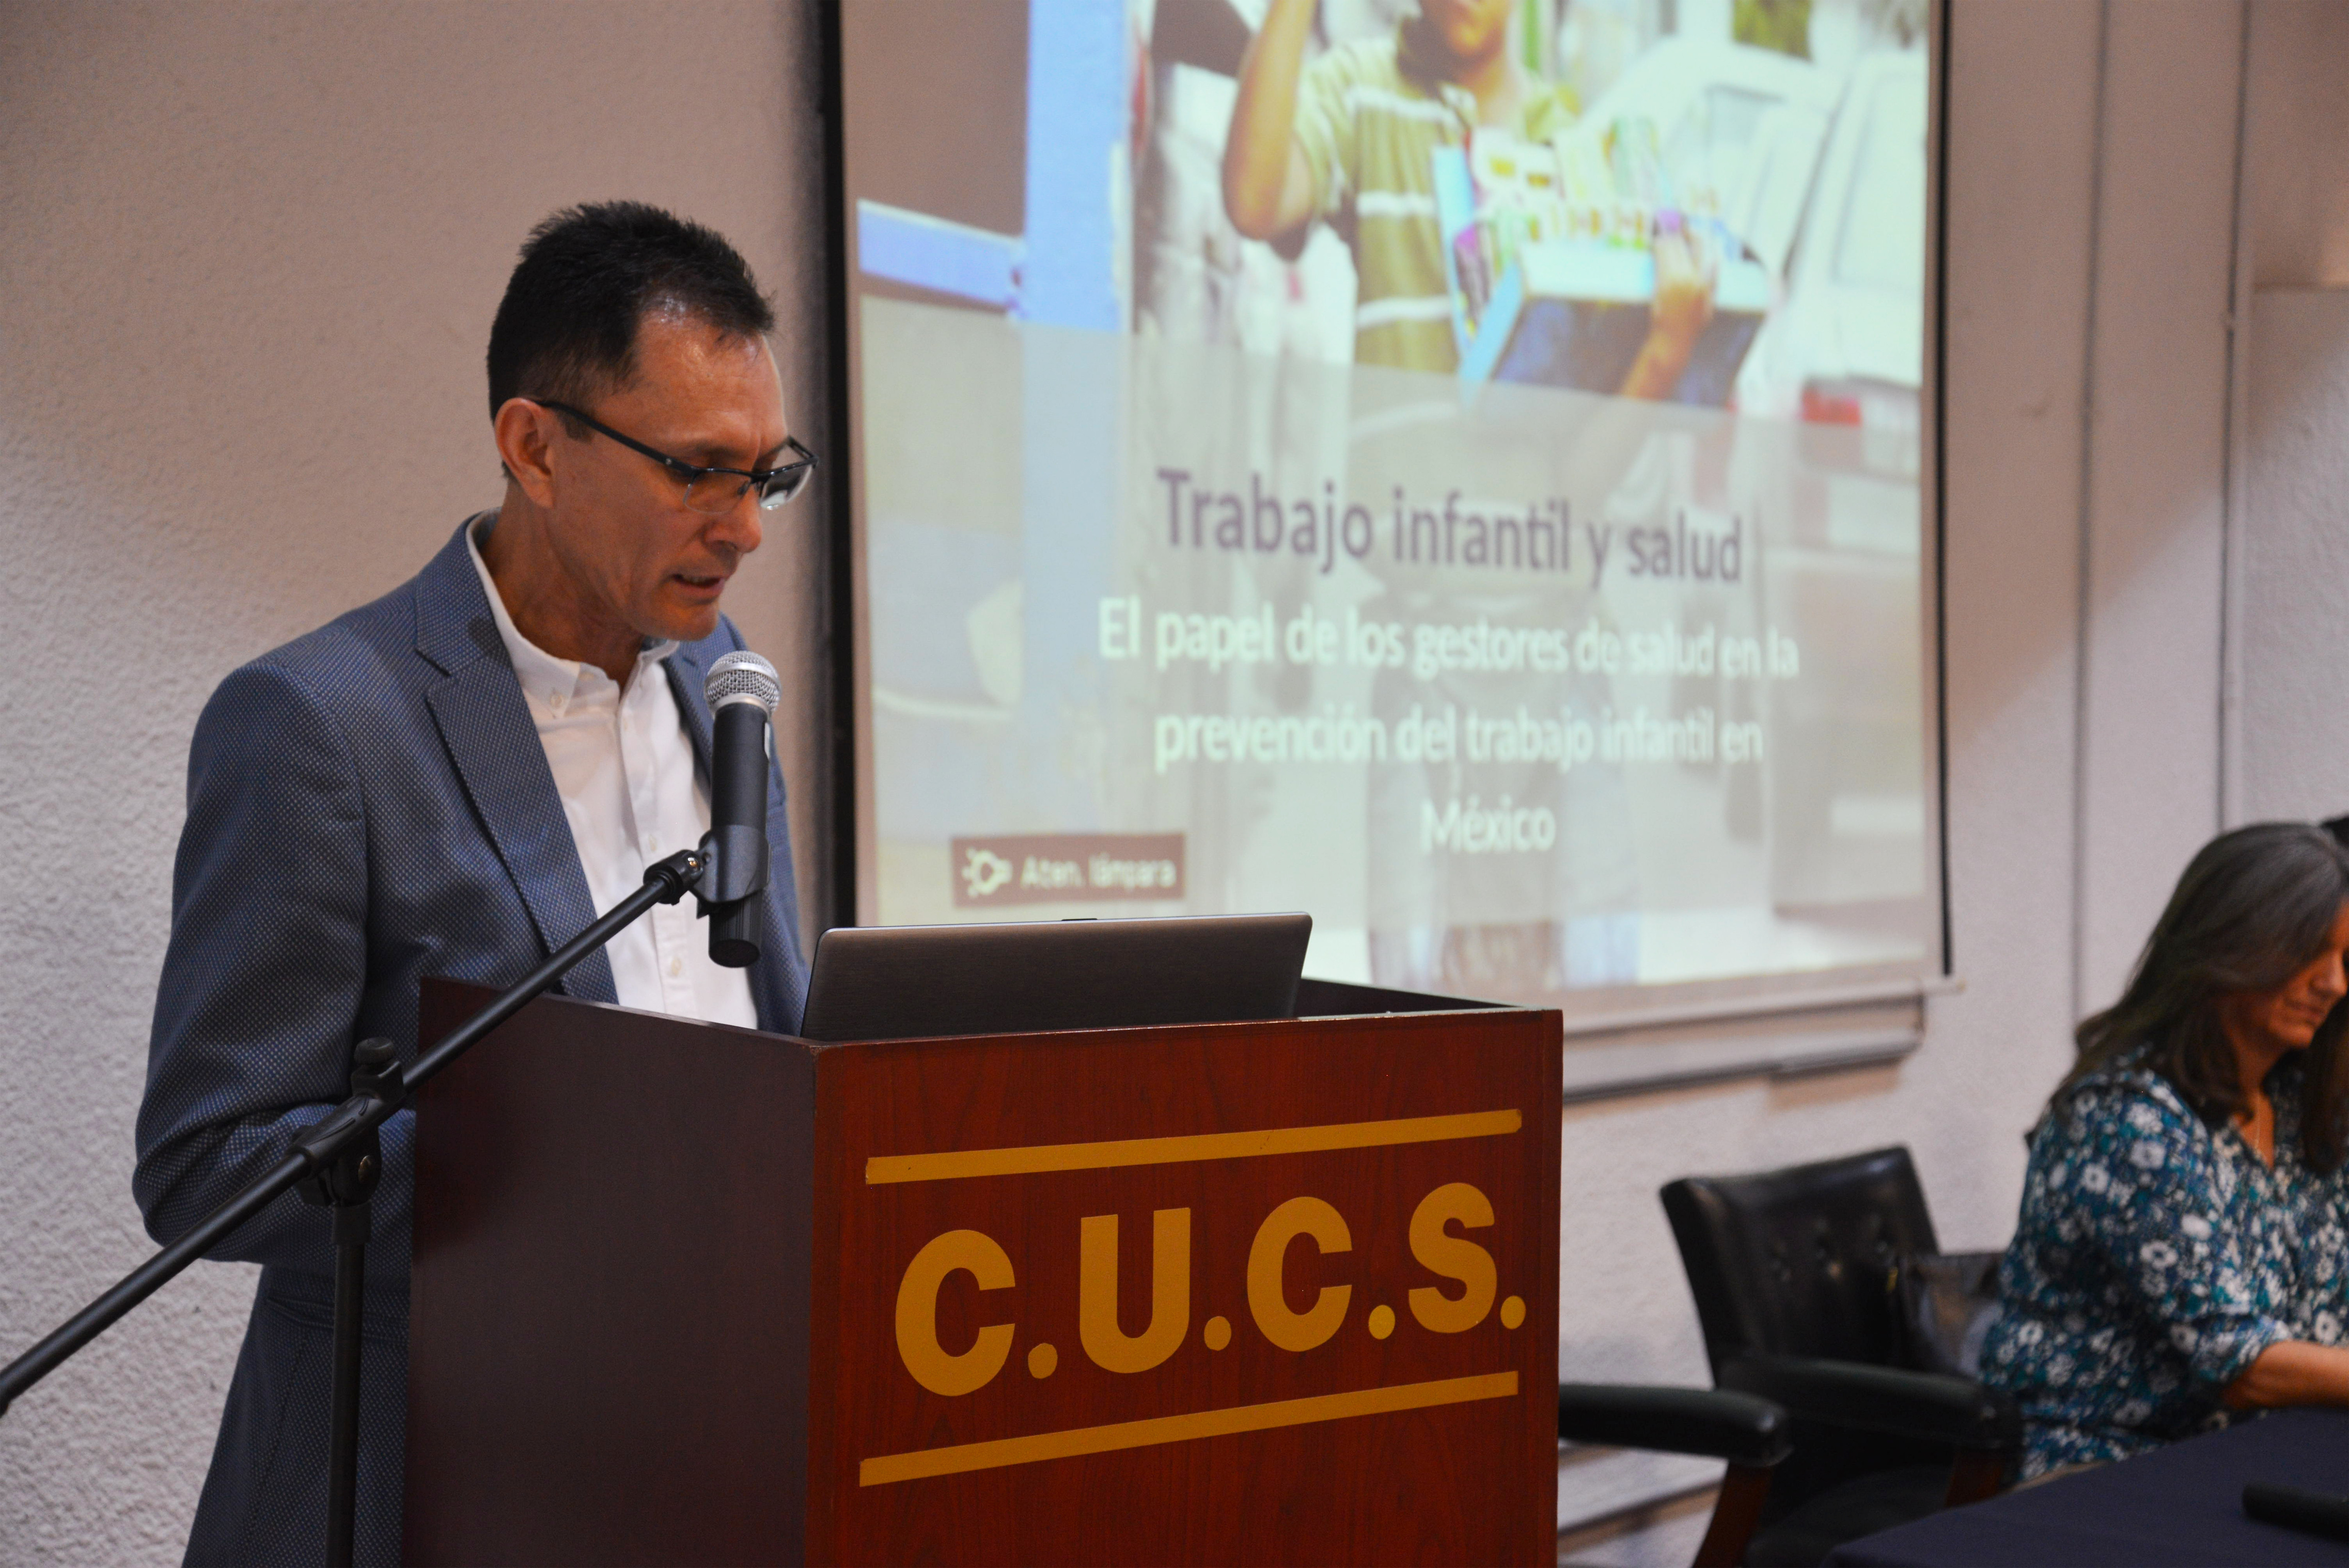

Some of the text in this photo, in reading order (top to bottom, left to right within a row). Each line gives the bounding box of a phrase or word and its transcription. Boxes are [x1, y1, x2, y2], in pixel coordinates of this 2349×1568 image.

[1156, 468, 1742, 589] Trabajo infantil y salud
[1098, 597, 1799, 679] El papel de los gestores de salud en la
[1154, 704, 1763, 774] prevención del trabajo infantil en
[1419, 794, 1557, 854] México
[895, 1182, 1526, 1397] C.U.C.S.
